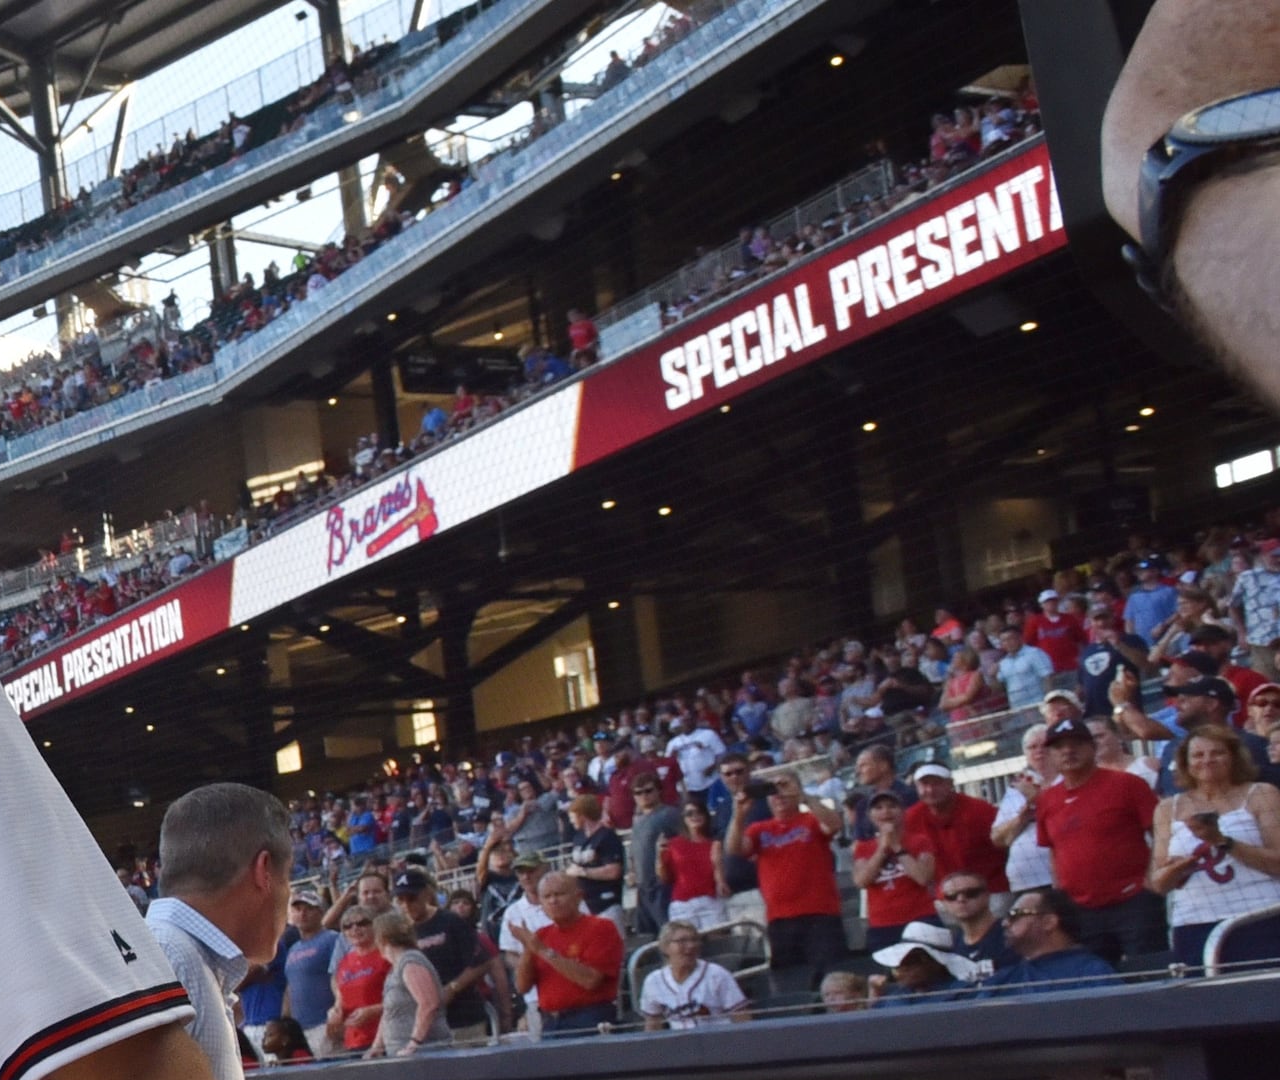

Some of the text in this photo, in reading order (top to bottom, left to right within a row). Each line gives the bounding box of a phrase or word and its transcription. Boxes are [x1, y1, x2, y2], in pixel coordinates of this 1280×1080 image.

[660, 283, 827, 411] SPECIAL
[326, 472, 411, 576] Braves
[4, 598, 184, 716] SPECIAL PRESENTATION
